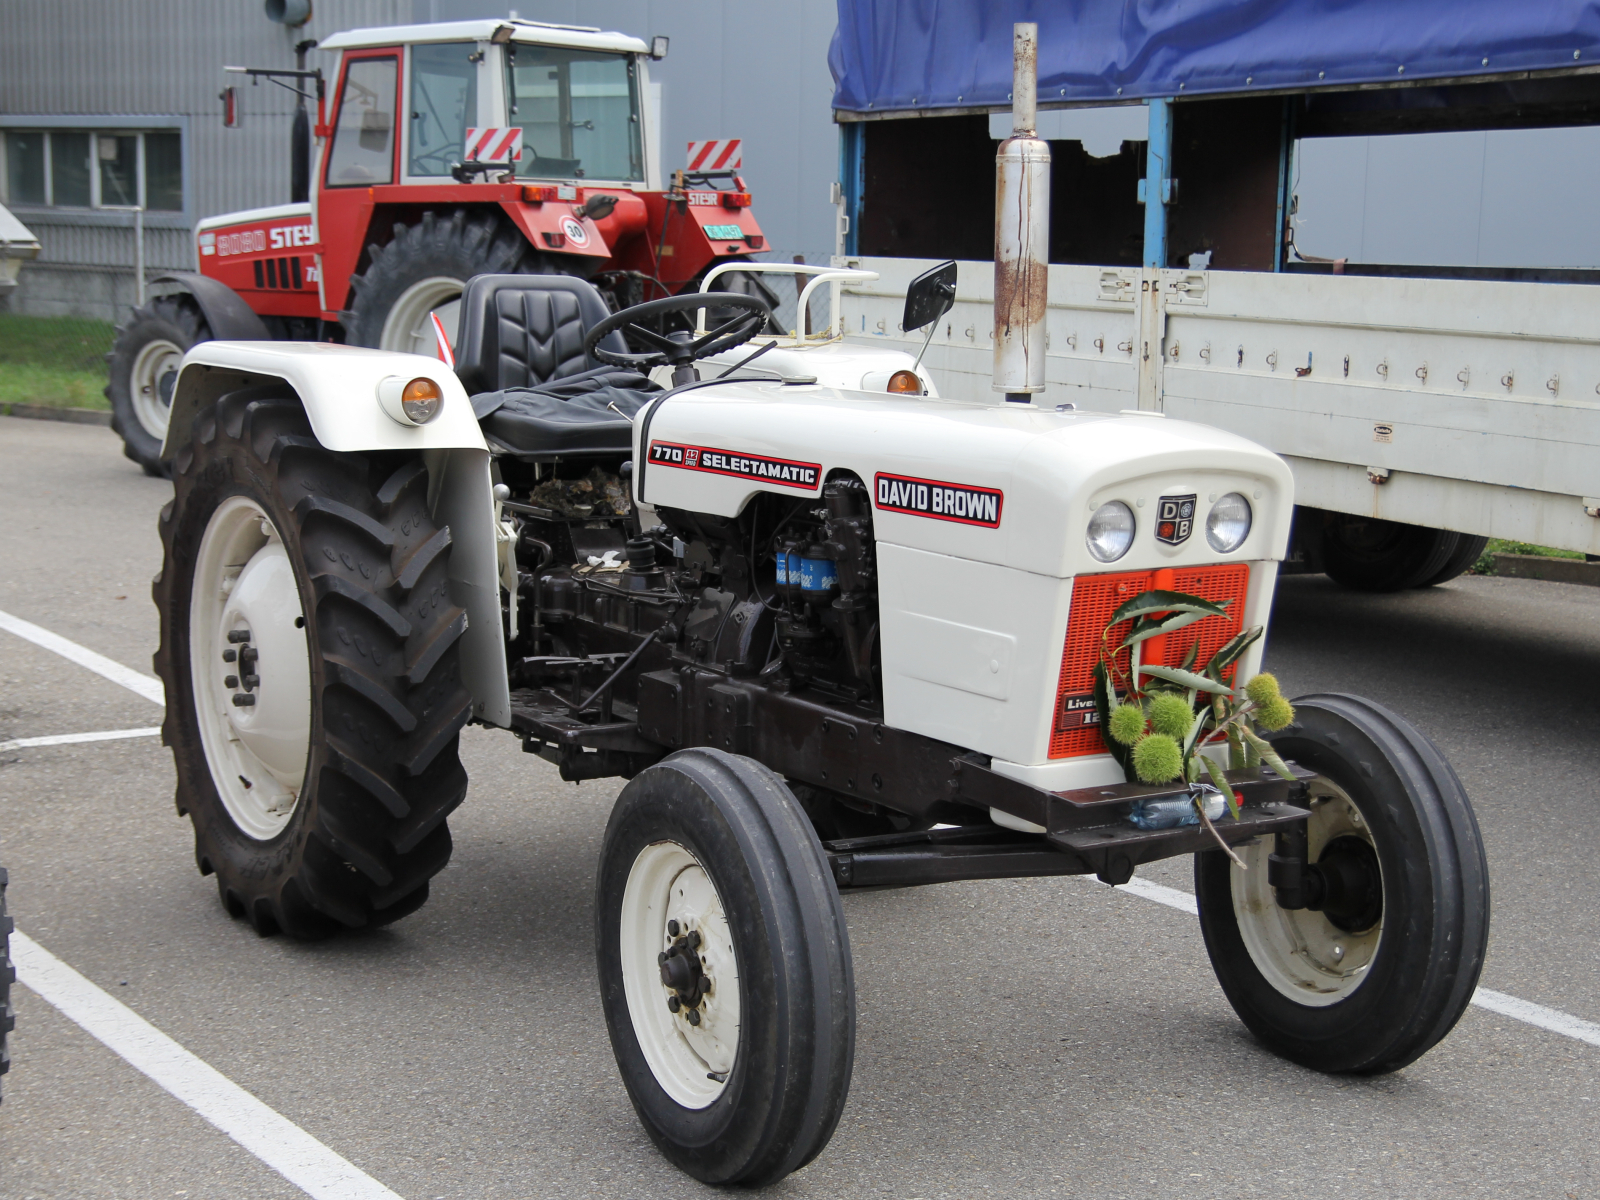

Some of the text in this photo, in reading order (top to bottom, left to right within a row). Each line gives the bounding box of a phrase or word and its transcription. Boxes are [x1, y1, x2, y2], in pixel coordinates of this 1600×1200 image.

[688, 193, 718, 206] STEYR
[567, 225, 582, 238] 30
[217, 229, 266, 257] 8080
[653, 446, 697, 462] 770 12
[703, 453, 815, 483] SELECTAMATIC
[878, 479, 996, 521] DAVID BROWN
[1163, 503, 1177, 518] D
[1179, 521, 1189, 537] B
